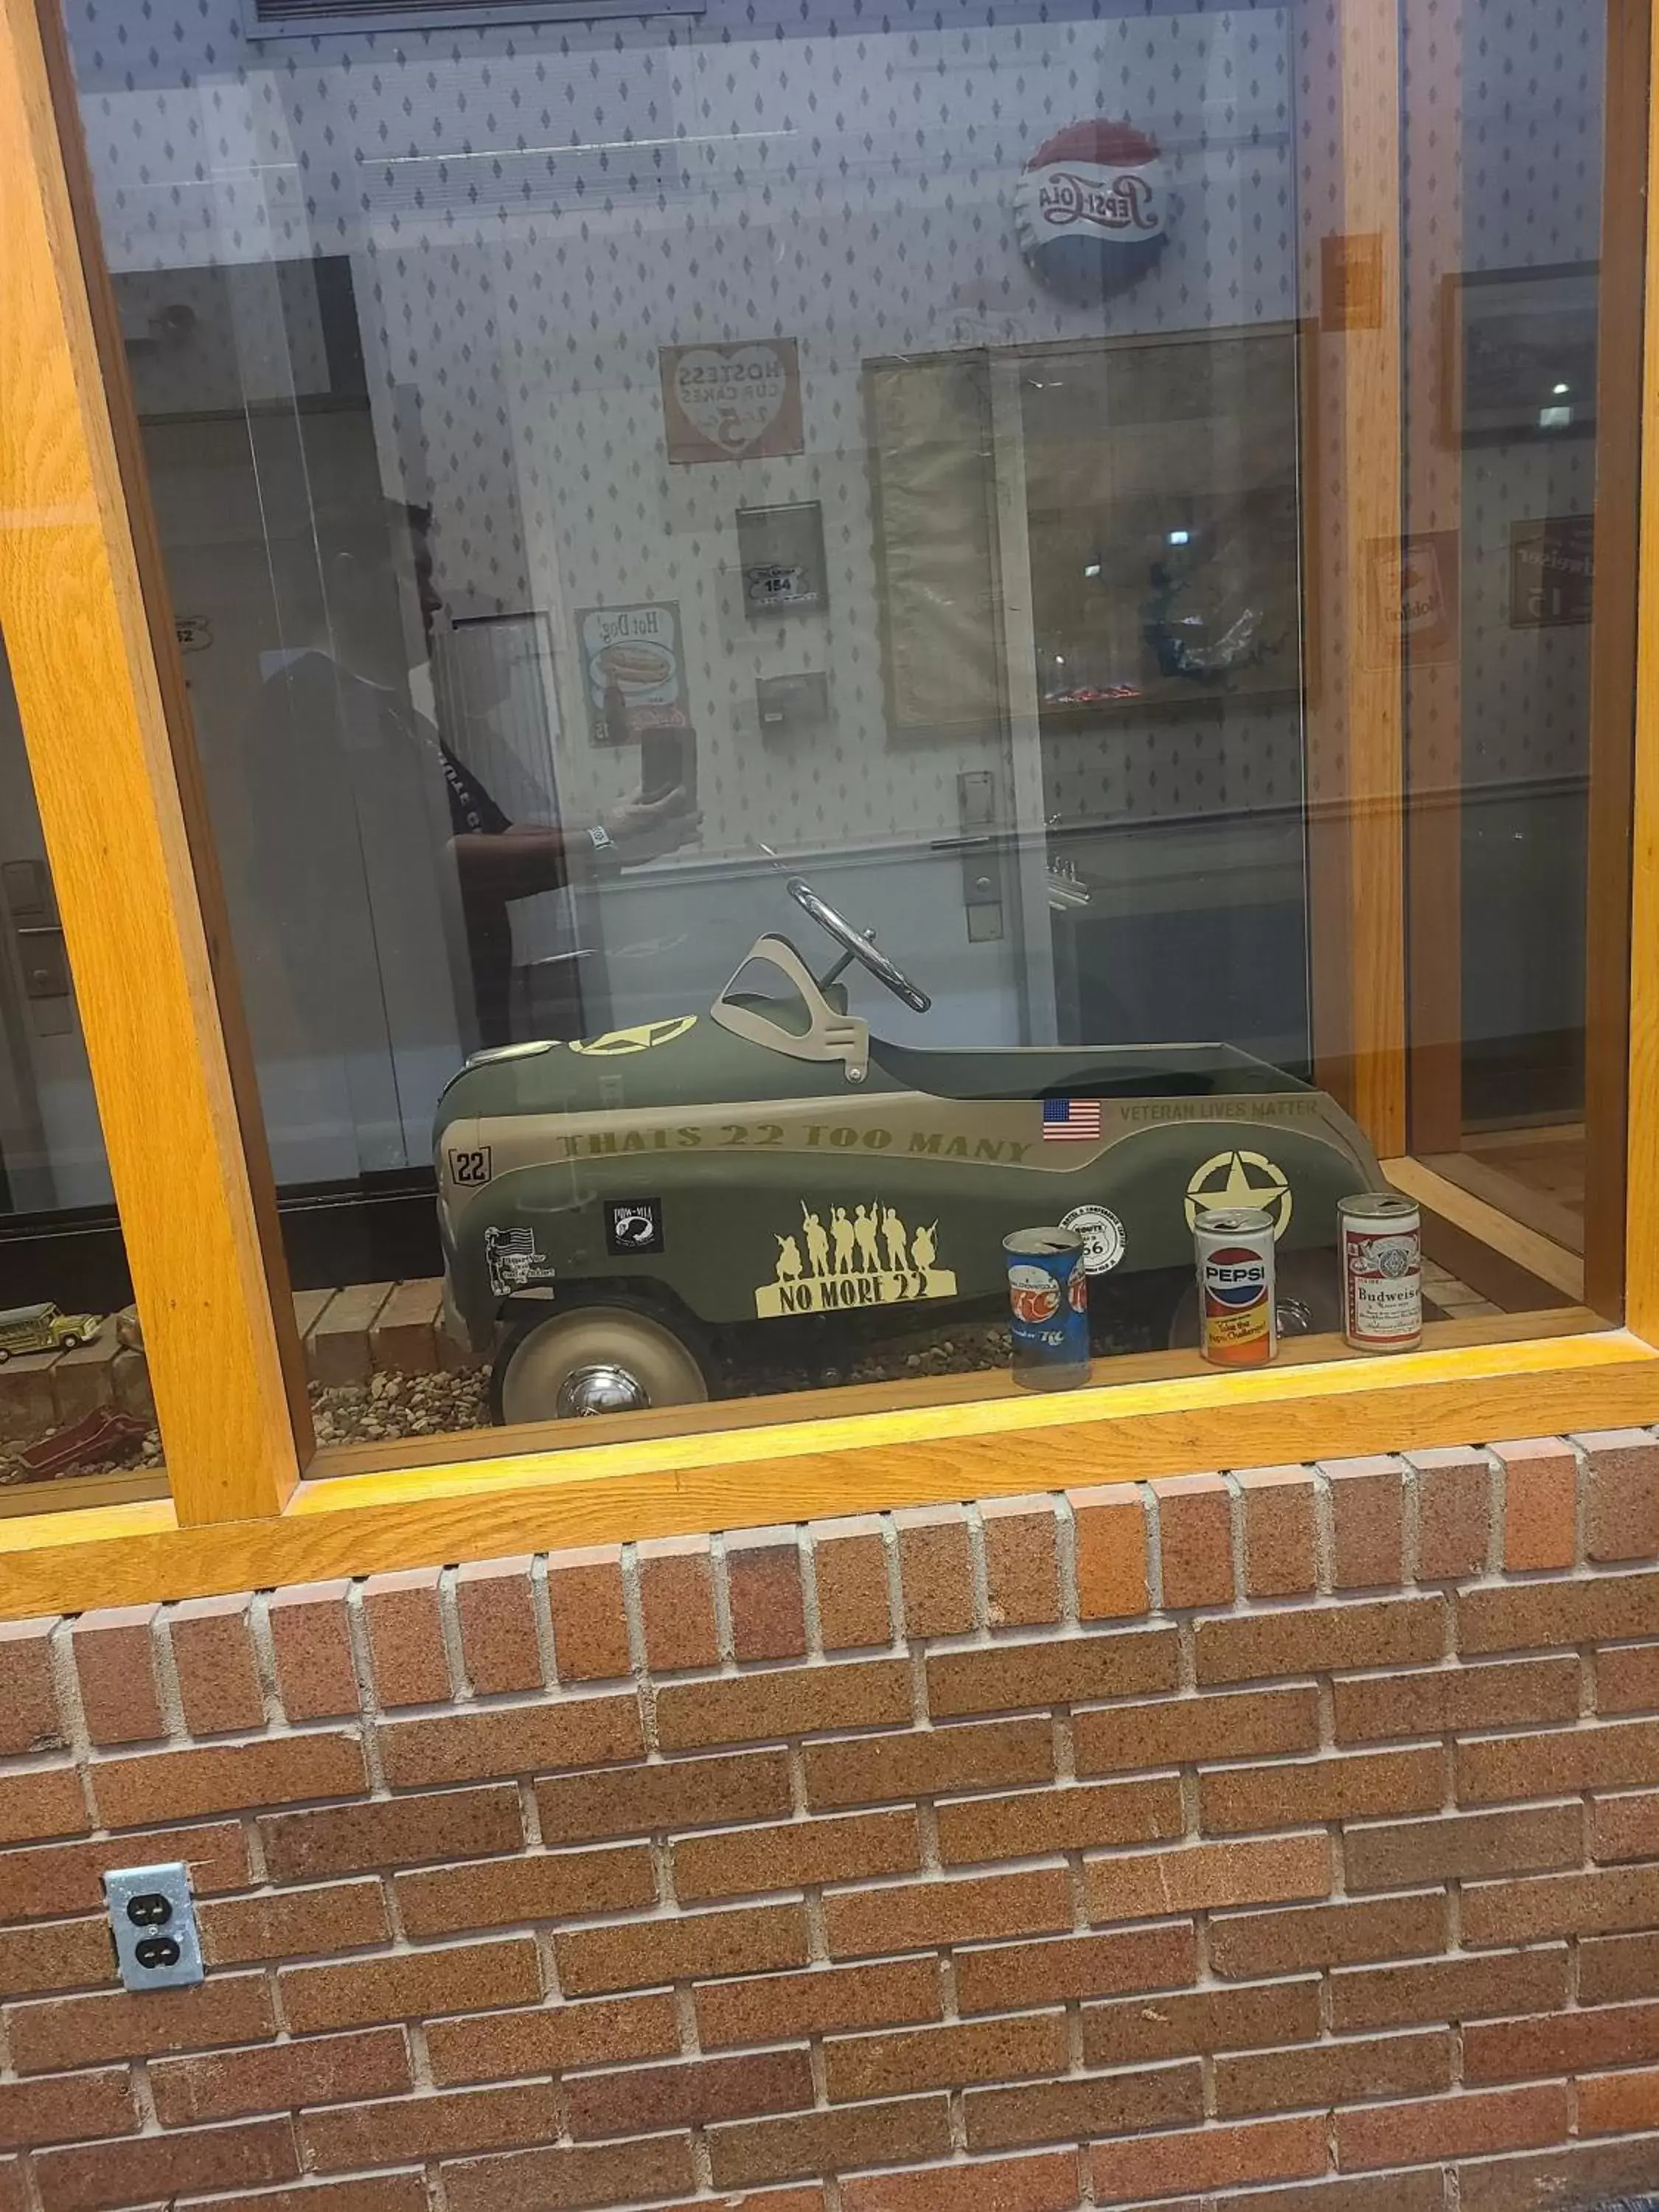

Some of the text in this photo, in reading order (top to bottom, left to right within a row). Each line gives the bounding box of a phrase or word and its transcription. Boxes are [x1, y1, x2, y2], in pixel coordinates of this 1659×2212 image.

[1120, 1099, 1318, 1121] VETERAN LIVES MATTER
[720, 1124, 784, 1146] 22
[803, 1124, 892, 1150] TOO
[908, 1132, 1032, 1164] MANY
[457, 1152, 485, 1180] 22
[1206, 1267, 1265, 1281] PEPSI
[779, 1271, 928, 1312] NO MORE 22
